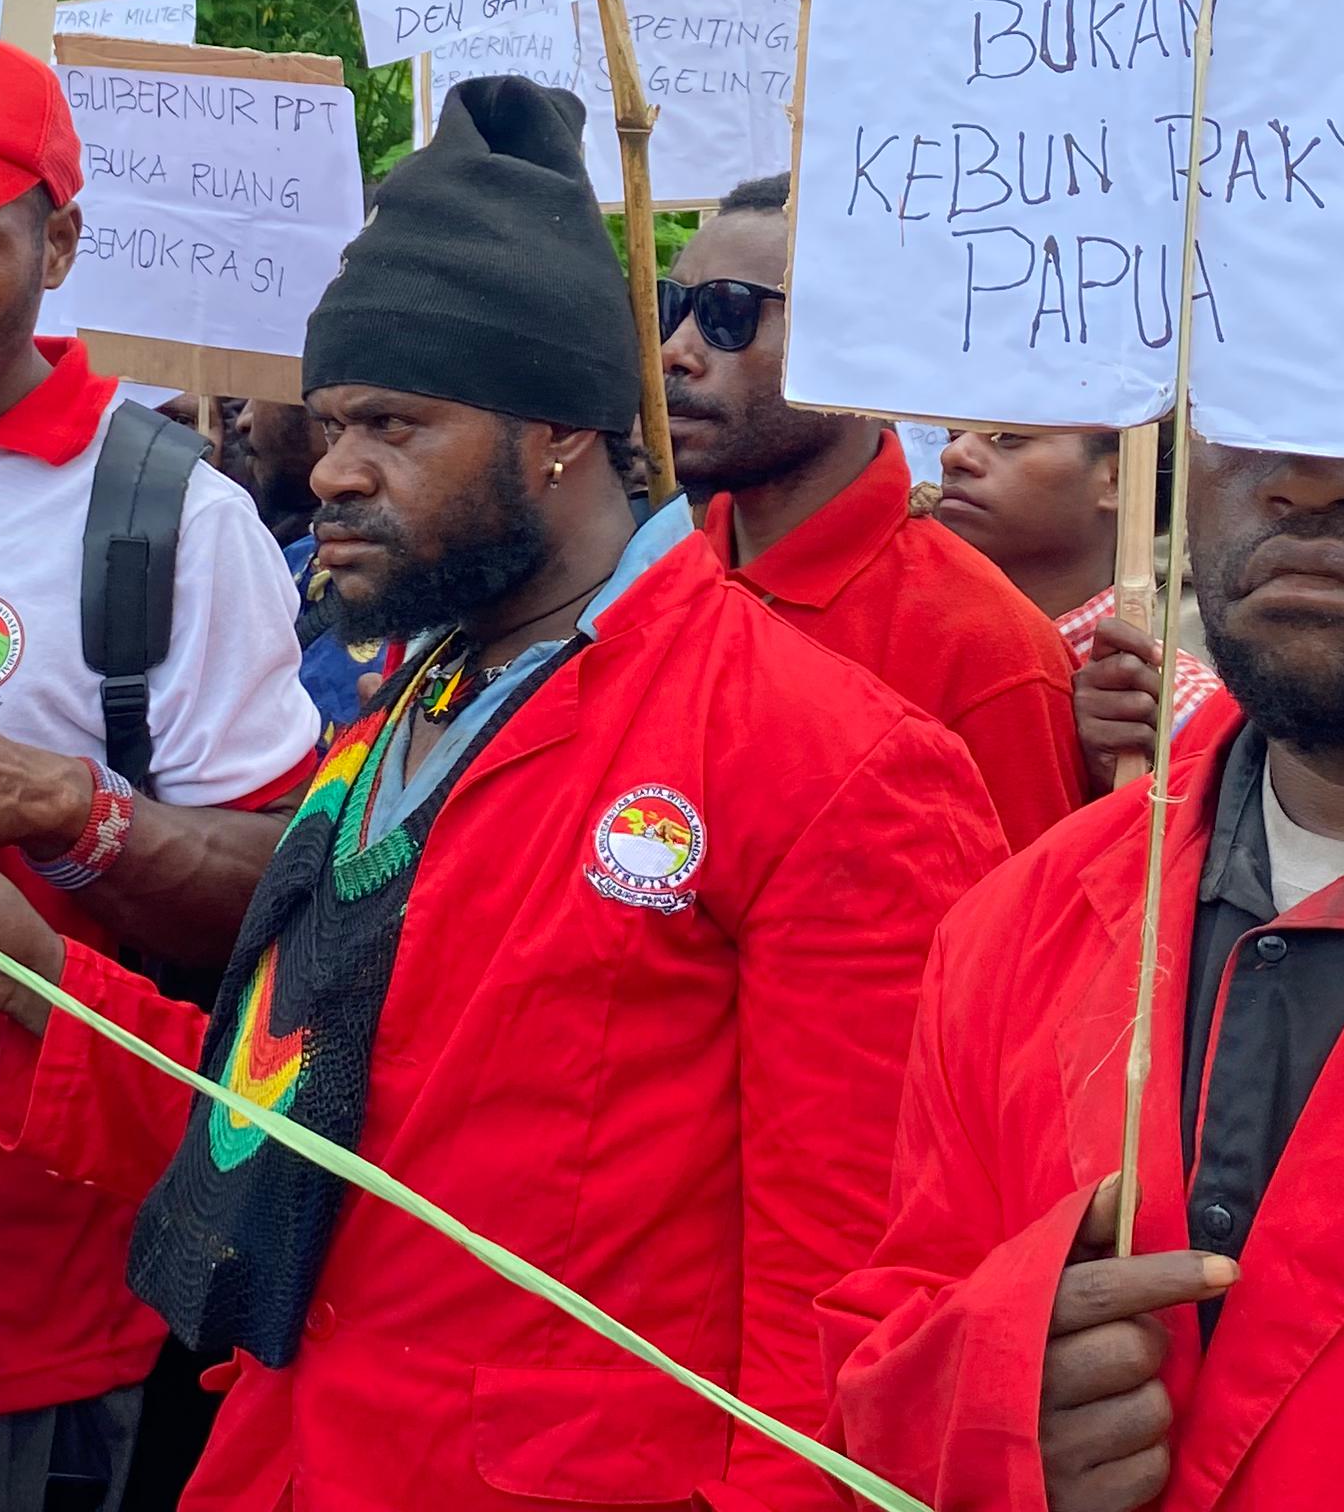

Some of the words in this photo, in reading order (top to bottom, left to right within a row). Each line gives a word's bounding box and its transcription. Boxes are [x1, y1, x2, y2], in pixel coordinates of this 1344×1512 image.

[56, 7, 111, 27] TARIK
[124, 4, 195, 26] MILITER
[67, 69, 258, 126] GUBERNUR
[273, 94, 339, 134] PPT
[85, 144, 168, 185] BUKA
[191, 163, 302, 213] RUANG
[847, 118, 1113, 224] KEBUN
[951, 225, 1226, 353] PAPUA
